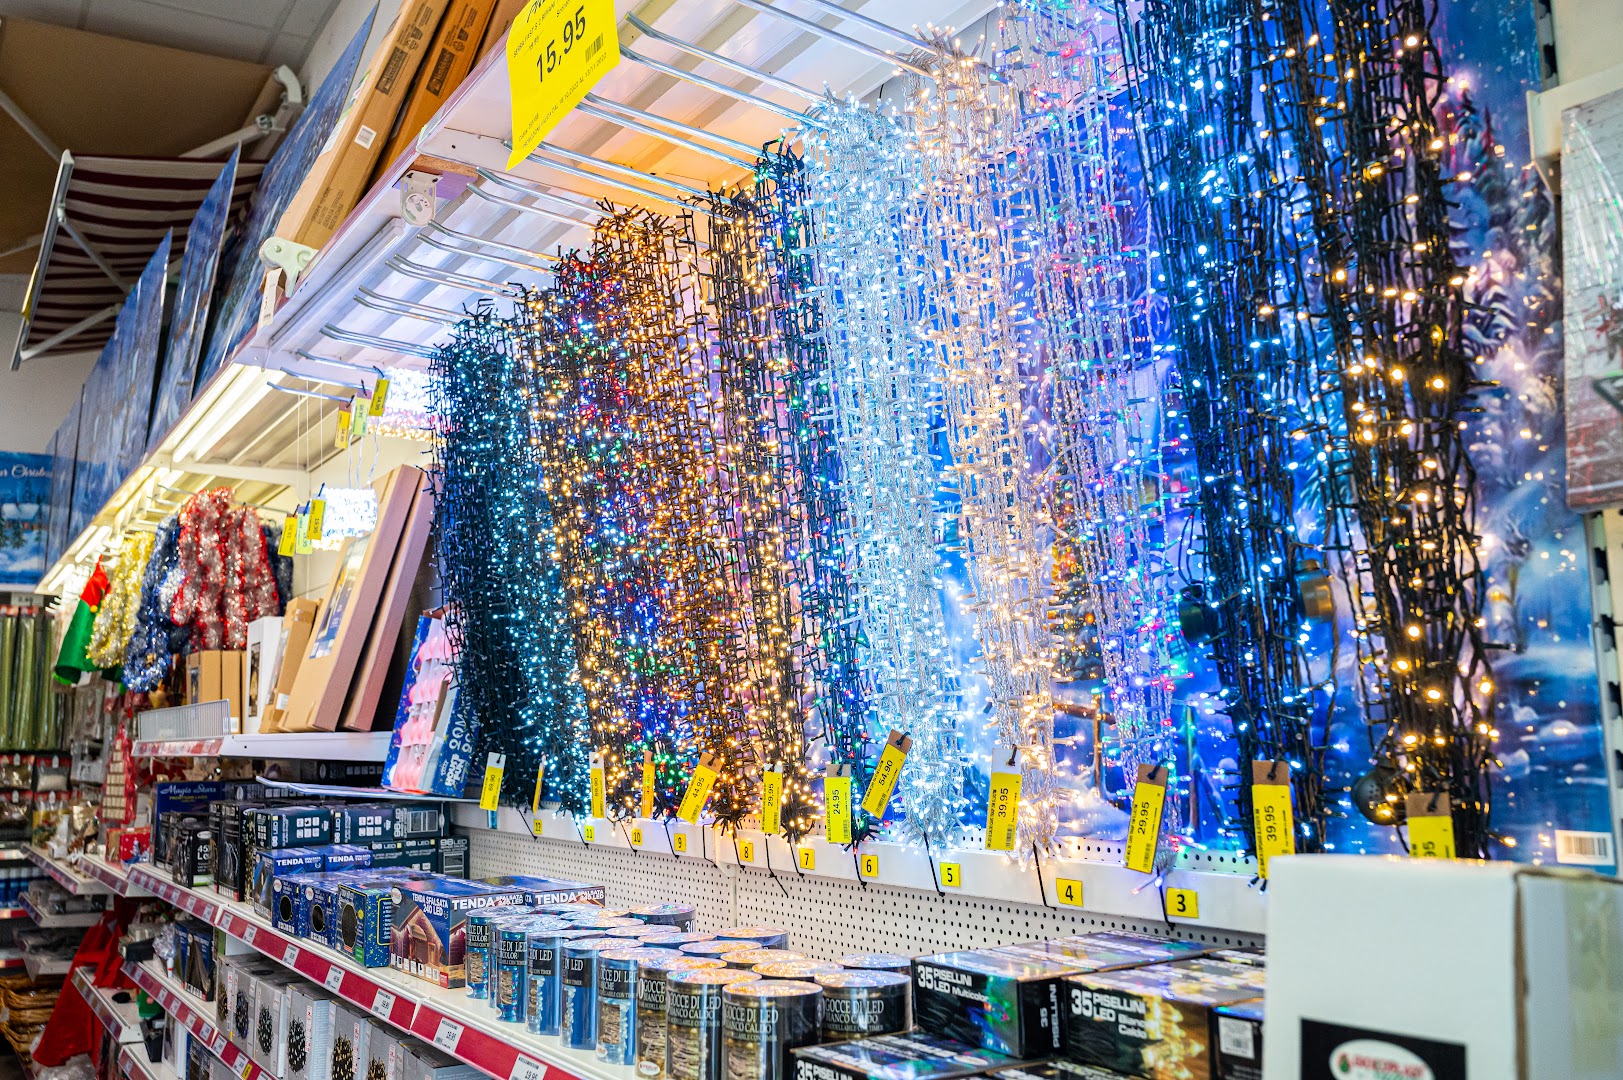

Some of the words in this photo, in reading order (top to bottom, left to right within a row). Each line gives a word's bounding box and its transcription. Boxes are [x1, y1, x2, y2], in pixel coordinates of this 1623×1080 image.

[536, 5, 586, 83] 15,95
[878, 760, 893, 787] 54,90
[693, 777, 705, 798] 44,95
[998, 788, 1010, 818] 39,95
[1137, 802, 1151, 836] 29,95
[1266, 805, 1278, 843] 39,95
[586, 828, 593, 839] 11
[633, 832, 641, 843] 10
[677, 838, 682, 848] 9
[328, 855, 354, 863] TENDA
[743, 846, 749, 859] 8
[804, 853, 810, 866] 7
[276, 858, 304, 867] TENDA
[866, 859, 872, 874] 6
[947, 866, 953, 883] 5
[412, 893, 426, 903] TENDA
[535, 892, 577, 905] TENDA
[1065, 885, 1074, 902] 4
[423, 903, 433, 914] 240
[433, 905, 444, 917] LED
[451, 898, 495, 911] TENDA
[1177, 894, 1186, 912] 3
[476, 926, 483, 936] DI
[506, 941, 513, 952] DI
[514, 941, 528, 953] LED
[539, 949, 553, 960] LED
[571, 959, 583, 971] LED
[614, 970, 621, 982] DI
[917, 964, 934, 989] 35
[933, 968, 973, 987] PISELLINI
[644, 980, 666, 994] GOCCE
[934, 979, 950, 994] LED
[952, 986, 989, 1002] Multicolor
[690, 995, 700, 1009] DI
[704, 996, 722, 1010] LED
[825, 998, 850, 1014] GOCCE
[852, 1000, 863, 1014] DI
[866, 1000, 885, 1014] LED
[1071, 988, 1093, 1017] 35
[1093, 992, 1146, 1014] PISELLINI
[747, 1008, 756, 1023] DI
[760, 1009, 779, 1024] LED
[1039, 1007, 1049, 1028] 35
[1049, 983, 1061, 1049] PISELLINI
[1093, 1006, 1116, 1022] LED
[1118, 1024, 1147, 1040] Caldo
[797, 1060, 813, 1080] 35
